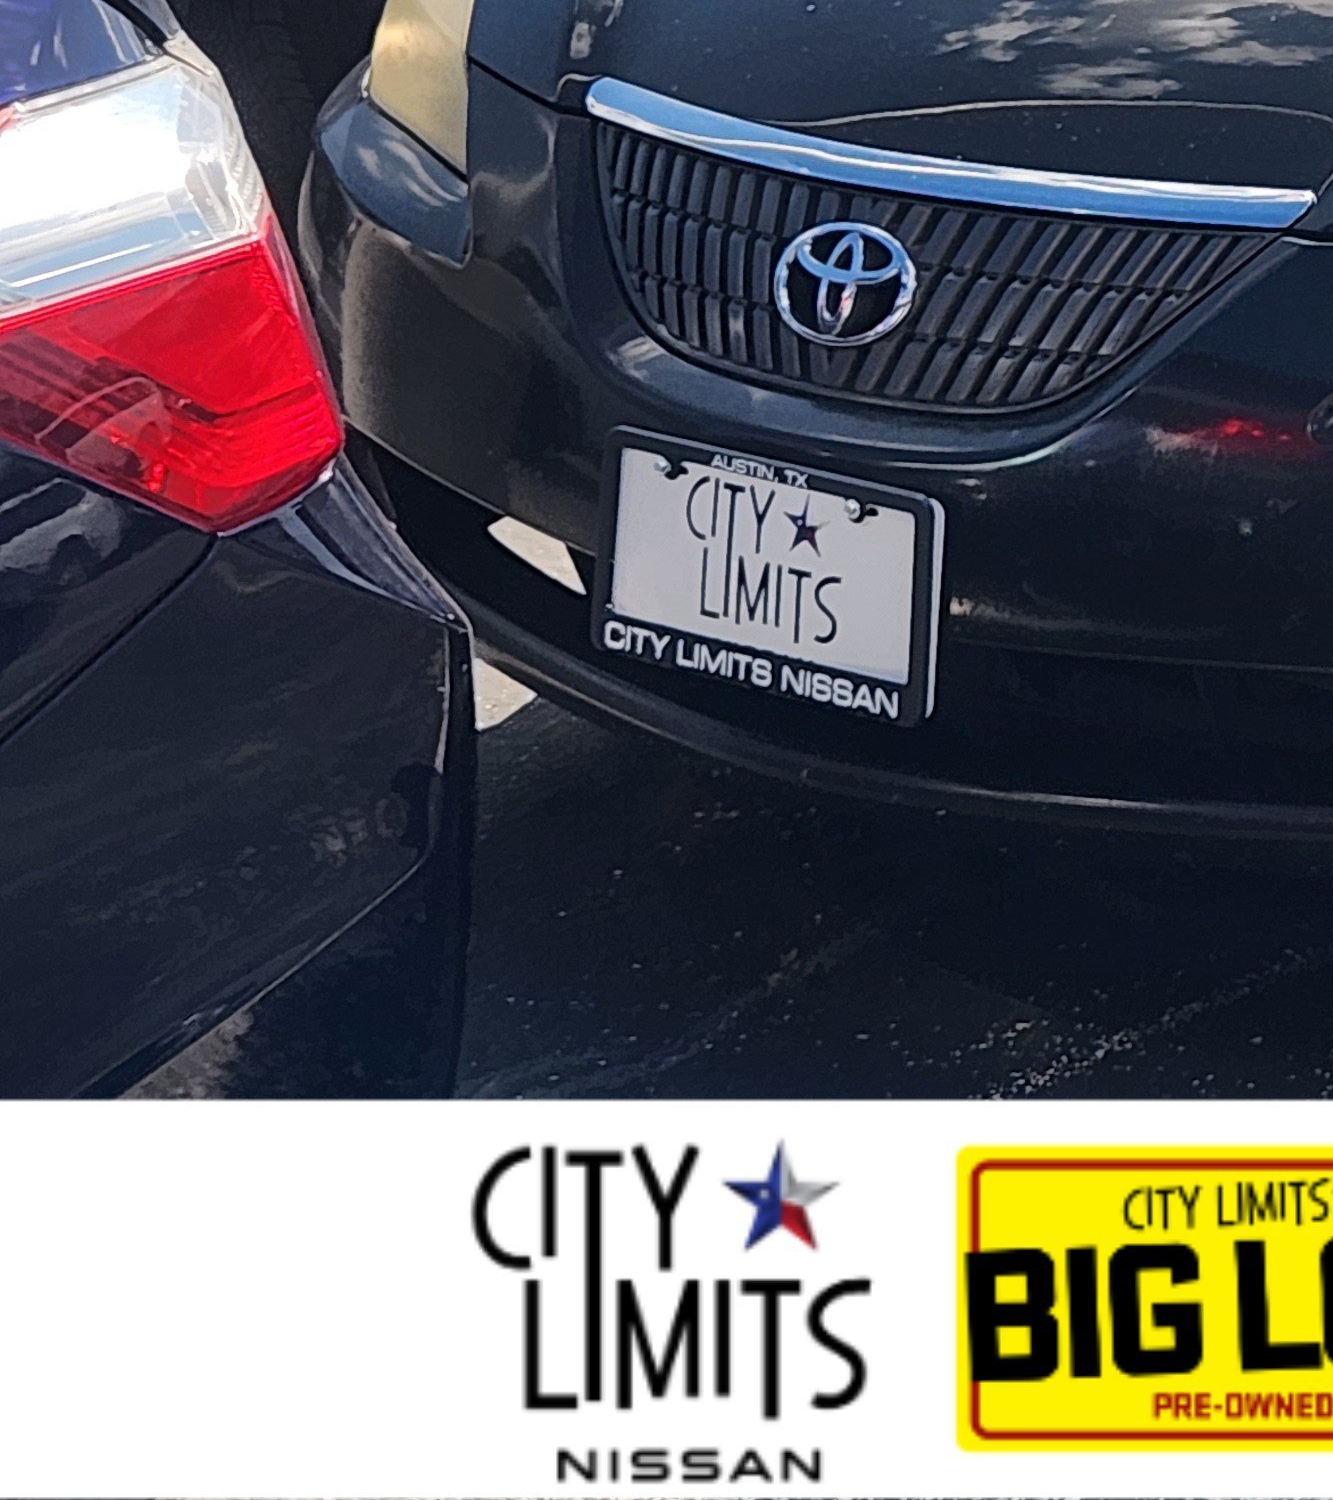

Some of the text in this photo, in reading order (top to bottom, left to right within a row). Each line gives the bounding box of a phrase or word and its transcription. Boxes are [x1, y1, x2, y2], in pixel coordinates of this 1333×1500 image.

[710, 454, 811, 490] AUSTIN, TX
[700, 547, 842, 645] LIMITS
[604, 619, 900, 720] CITY LIMITS NISSAN
